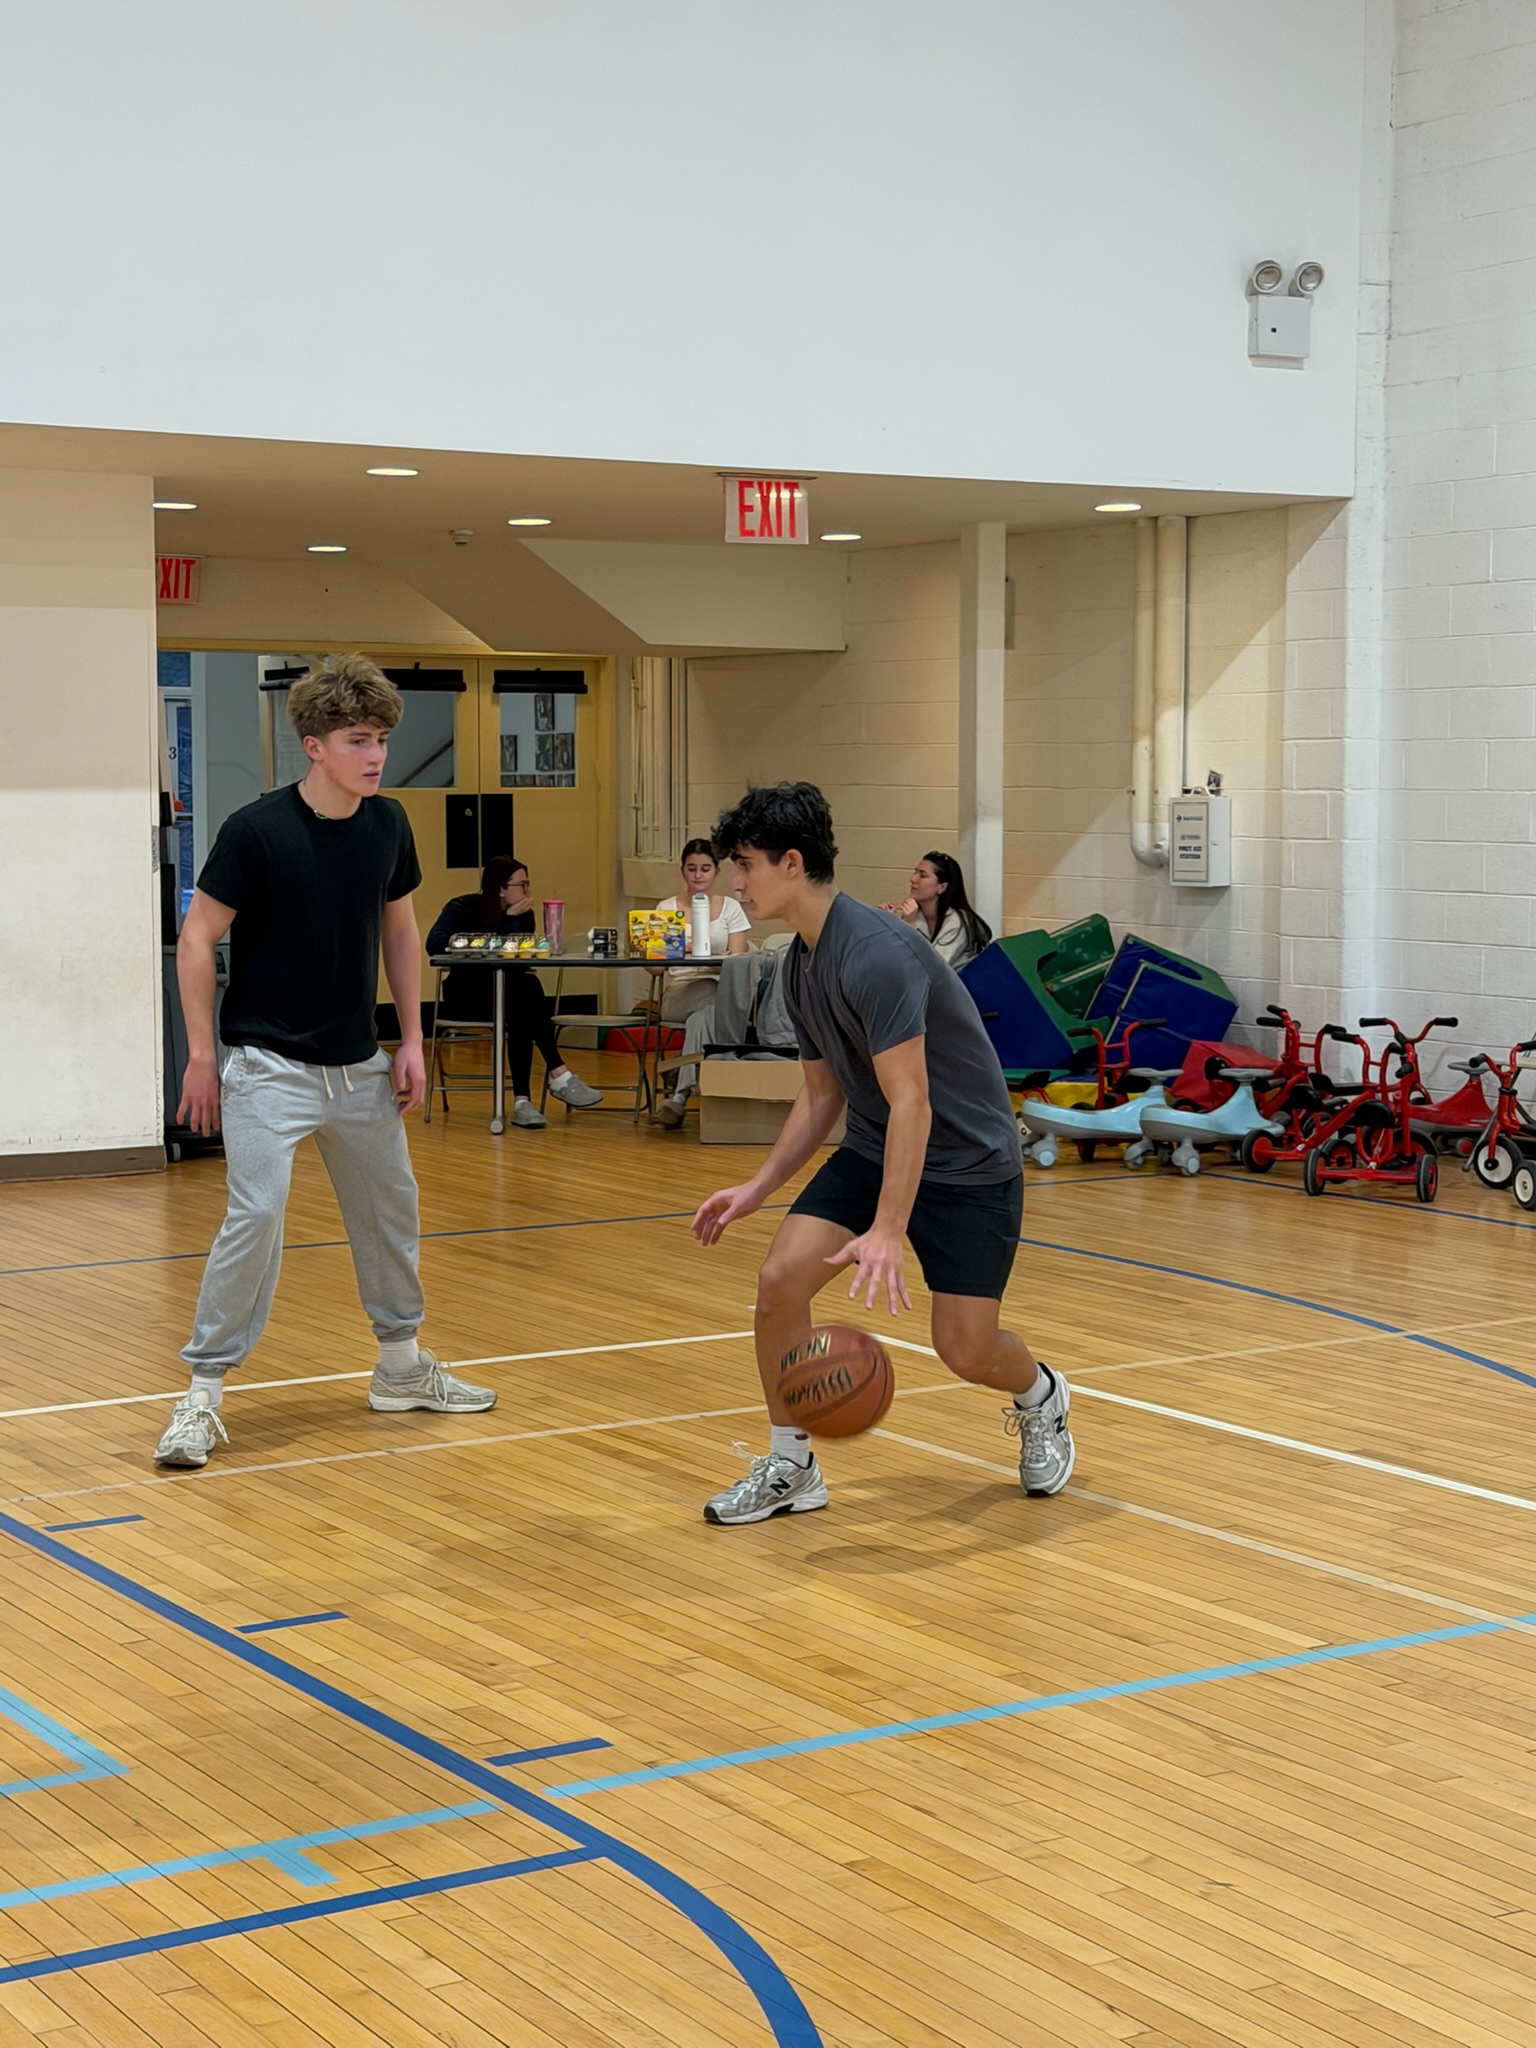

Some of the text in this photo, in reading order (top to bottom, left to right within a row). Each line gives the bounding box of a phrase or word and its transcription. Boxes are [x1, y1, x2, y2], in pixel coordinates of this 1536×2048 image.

[738, 480, 800, 538] EXIT
[156, 558, 196, 599] XIT
[168, 746, 177, 760] 3
